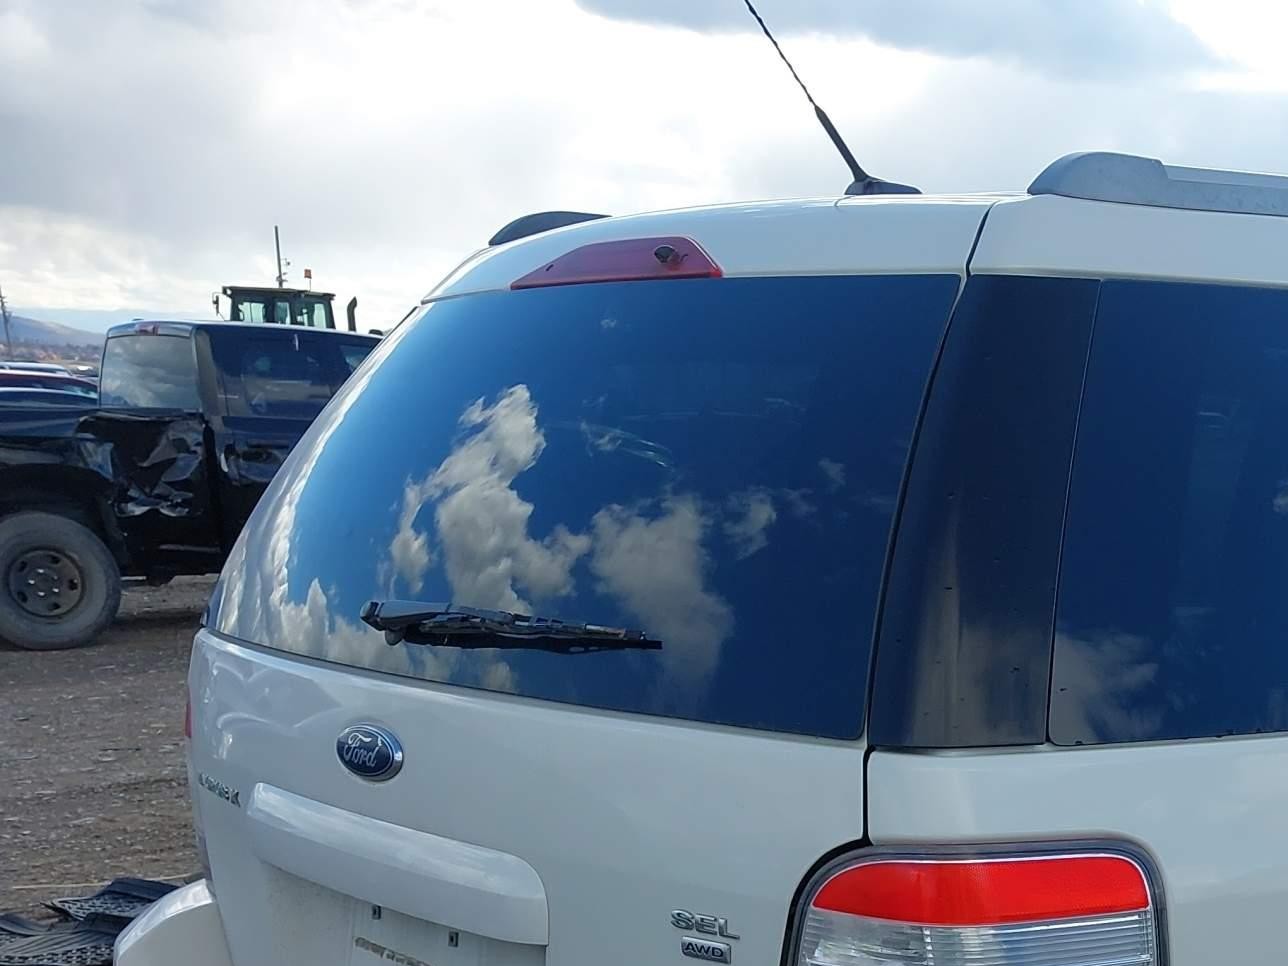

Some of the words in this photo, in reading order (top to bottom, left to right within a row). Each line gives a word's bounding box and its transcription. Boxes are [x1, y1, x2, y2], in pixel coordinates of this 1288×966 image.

[343, 732, 382, 767] Ford
[670, 909, 740, 940] SEL
[684, 942, 724, 958] AWD
